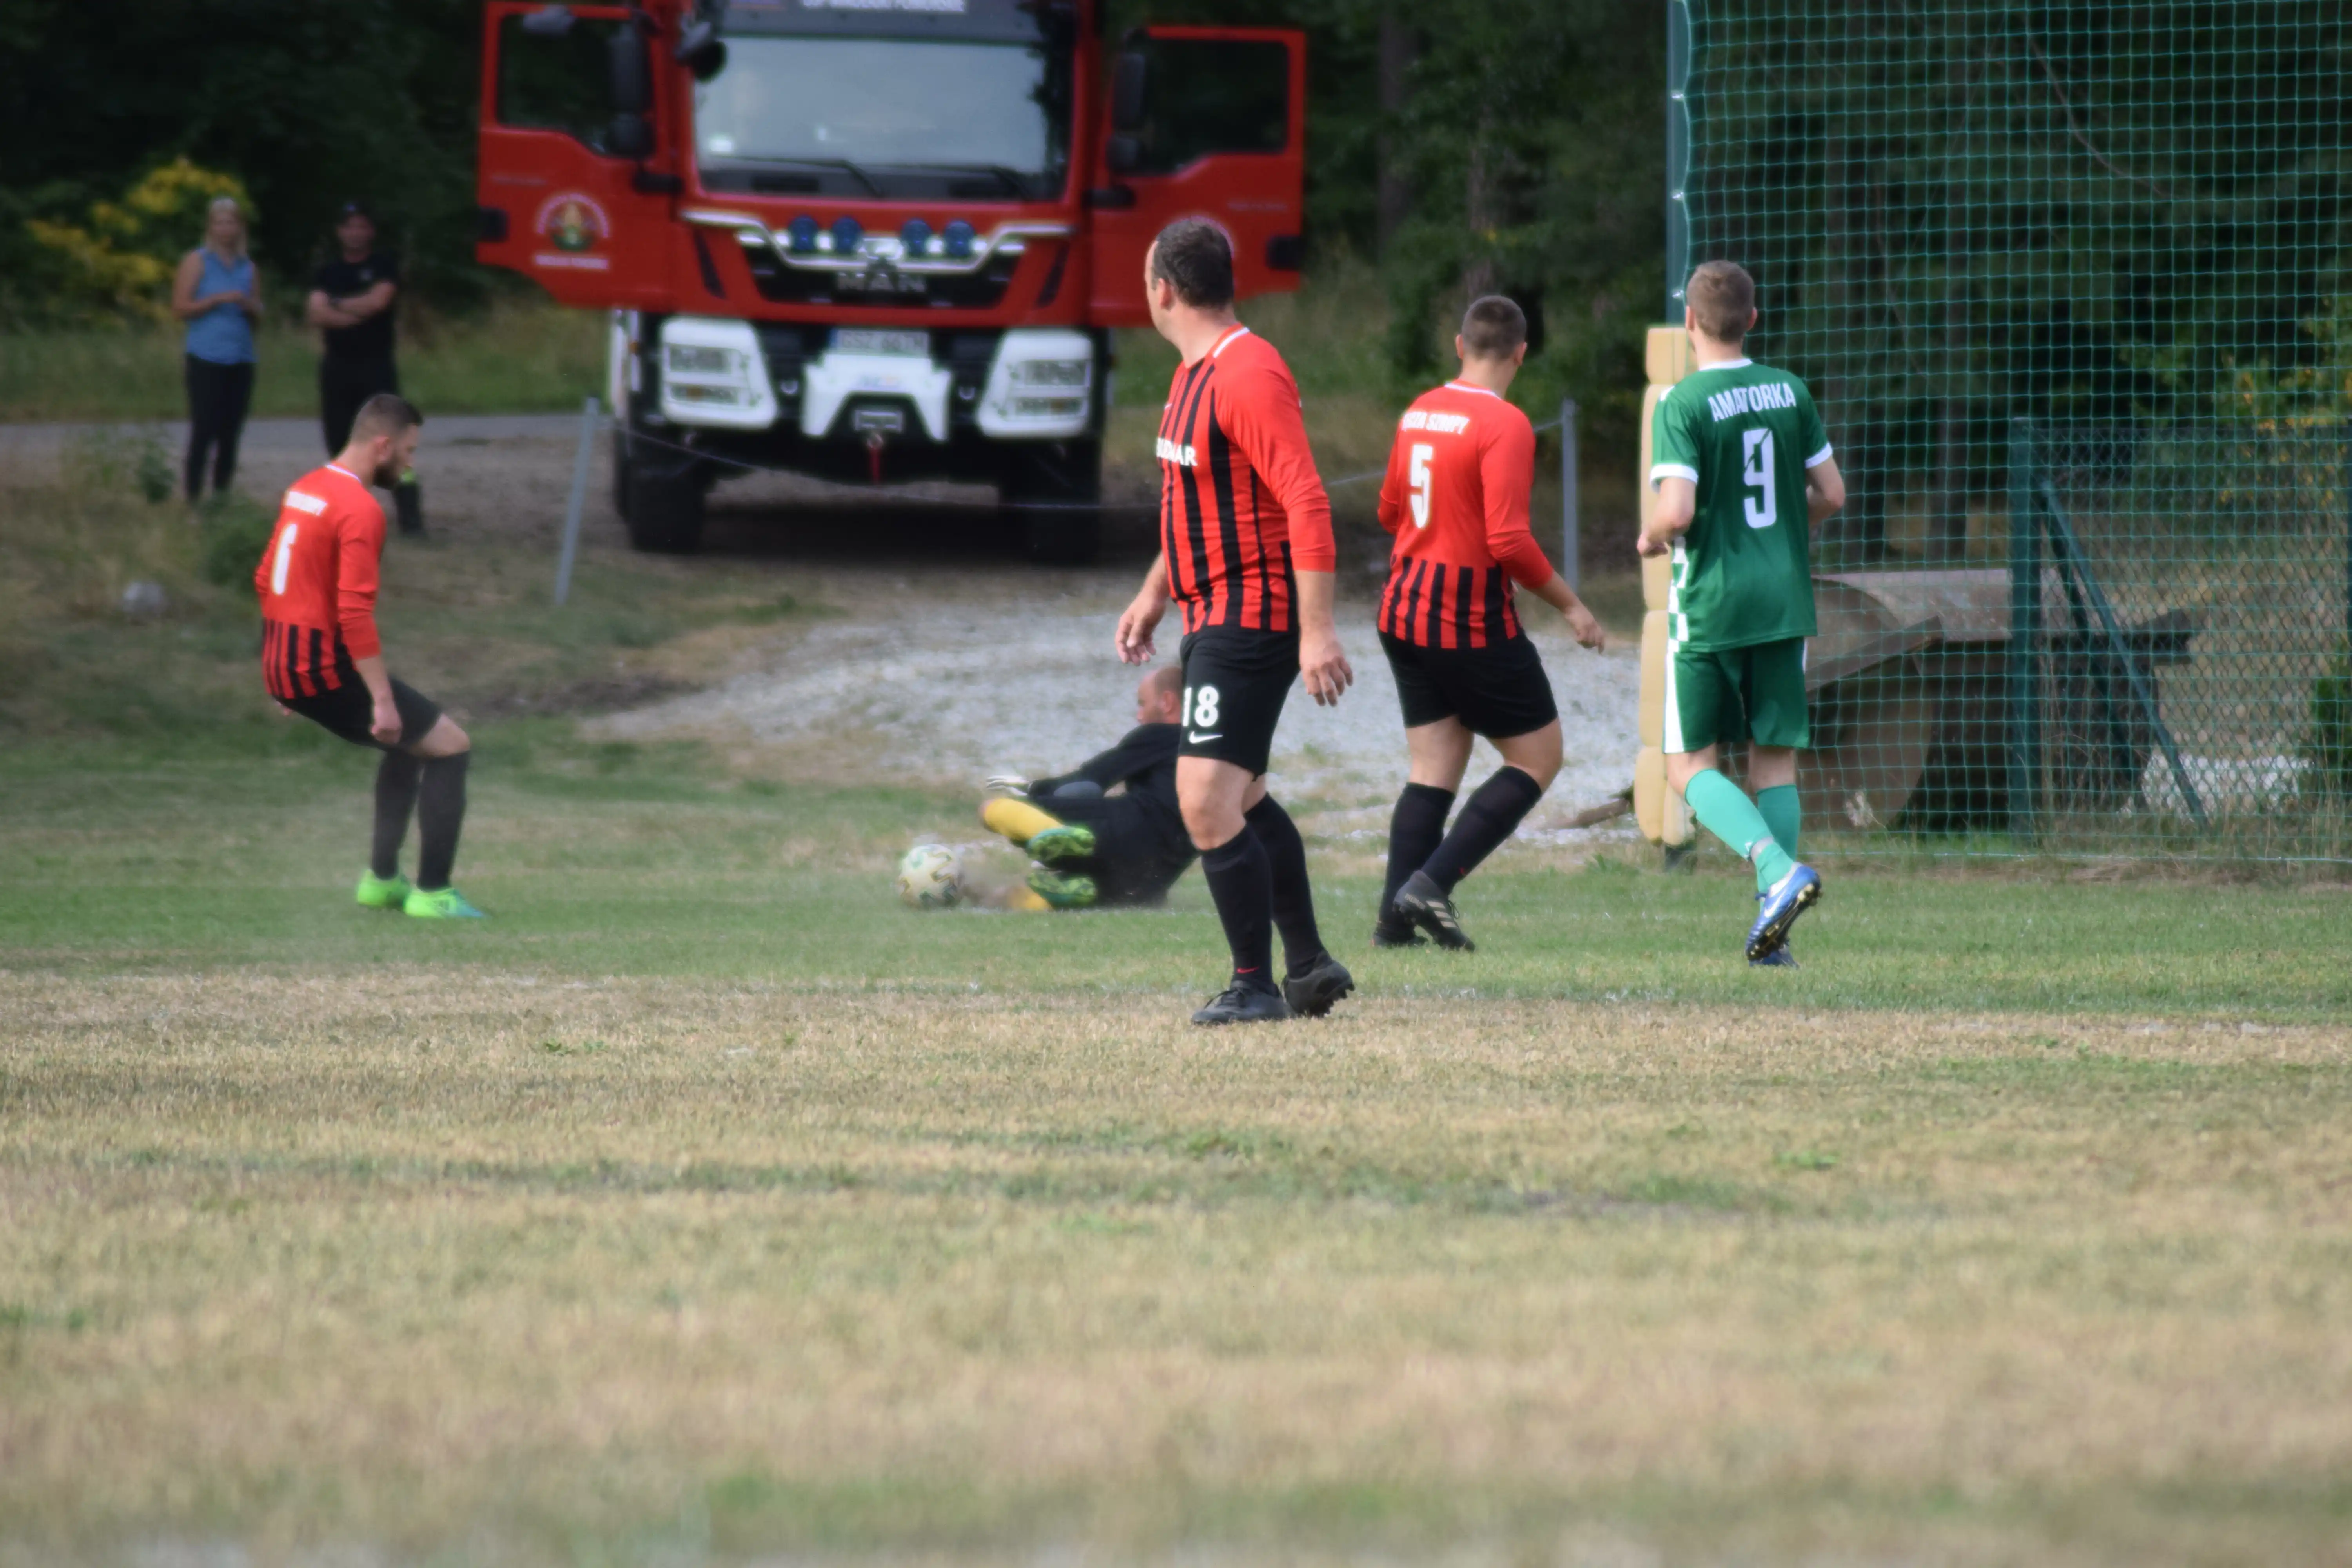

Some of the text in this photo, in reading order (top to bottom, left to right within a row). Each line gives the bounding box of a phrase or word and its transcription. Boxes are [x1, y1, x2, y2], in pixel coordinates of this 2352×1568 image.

[837, 272, 927, 292] MAN
[1708, 382, 1797, 422] AMATORKA
[1410, 443, 1433, 528] 5
[1743, 428, 1777, 528] 9
[1182, 686, 1219, 728] 18
